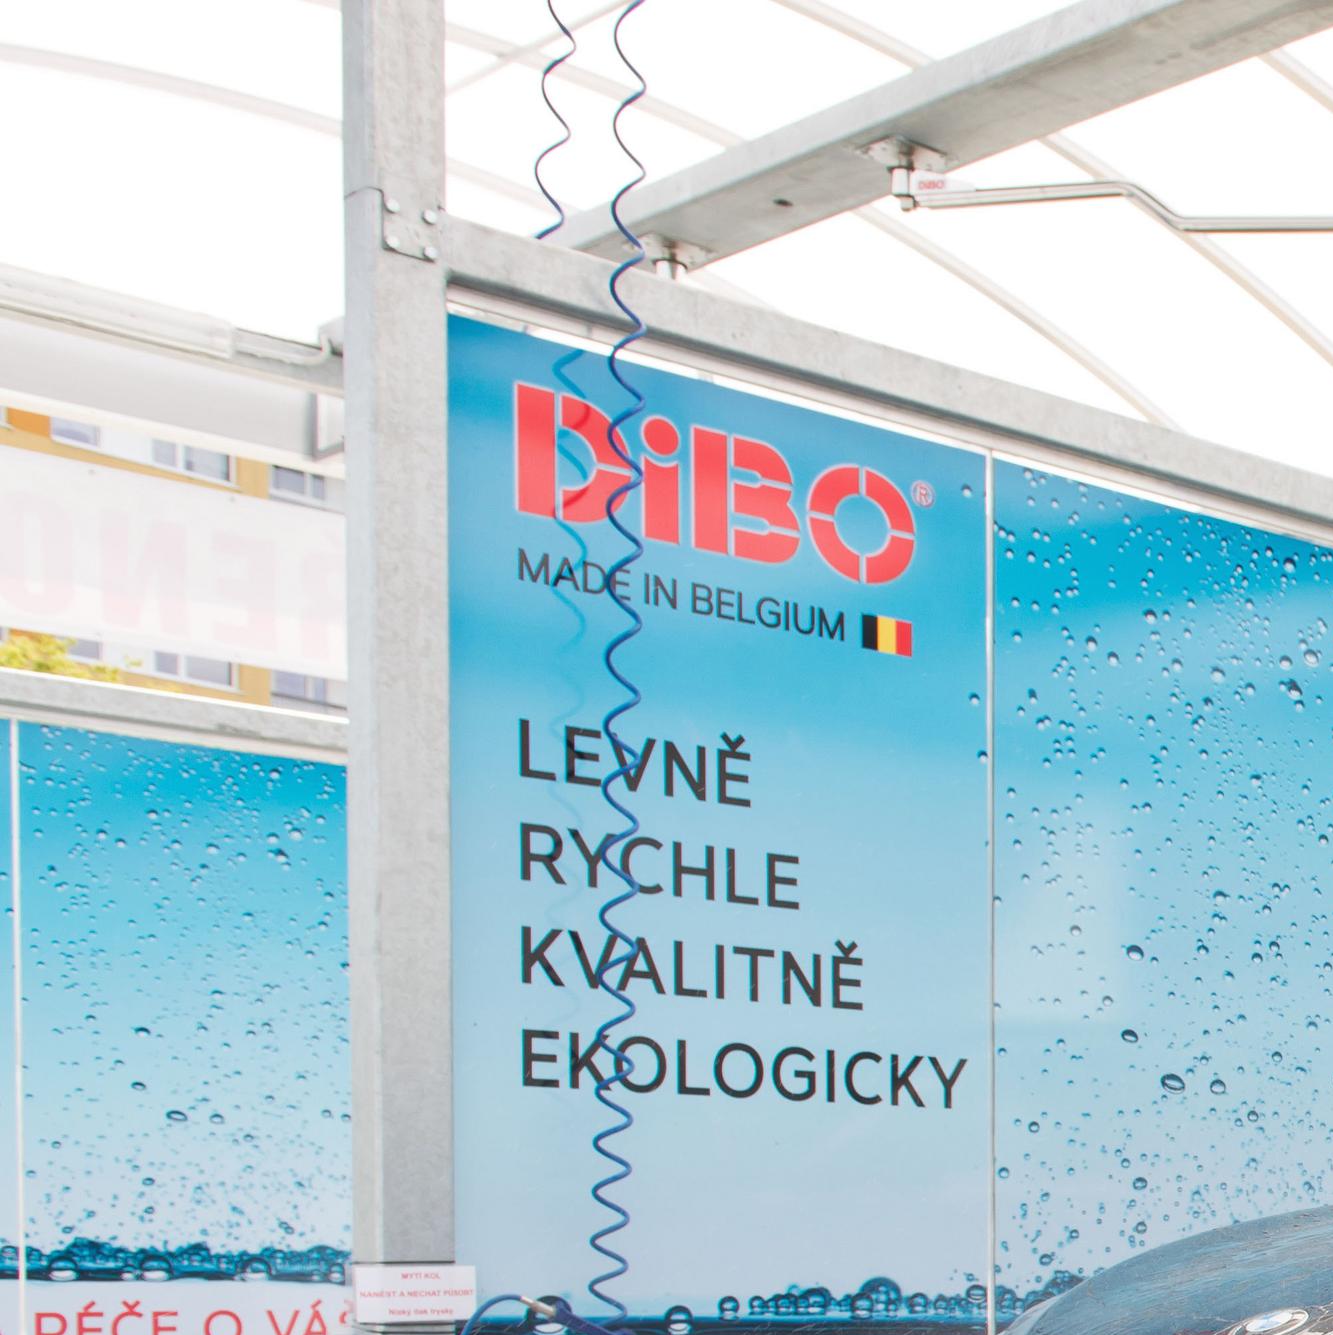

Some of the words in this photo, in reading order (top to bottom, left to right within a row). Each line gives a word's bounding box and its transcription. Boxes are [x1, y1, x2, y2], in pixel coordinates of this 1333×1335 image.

[515, 381, 916, 585] DiBO
[517, 547, 632, 601] MADE
[643, 573, 678, 611] IN
[690, 582, 846, 642] BELGIUM
[518, 717, 752, 808] LEVNĚ
[519, 821, 801, 911] RYCHLE
[520, 924, 864, 1012] KVALITNĚ
[521, 1027, 969, 1110] EKOLOGICKY
